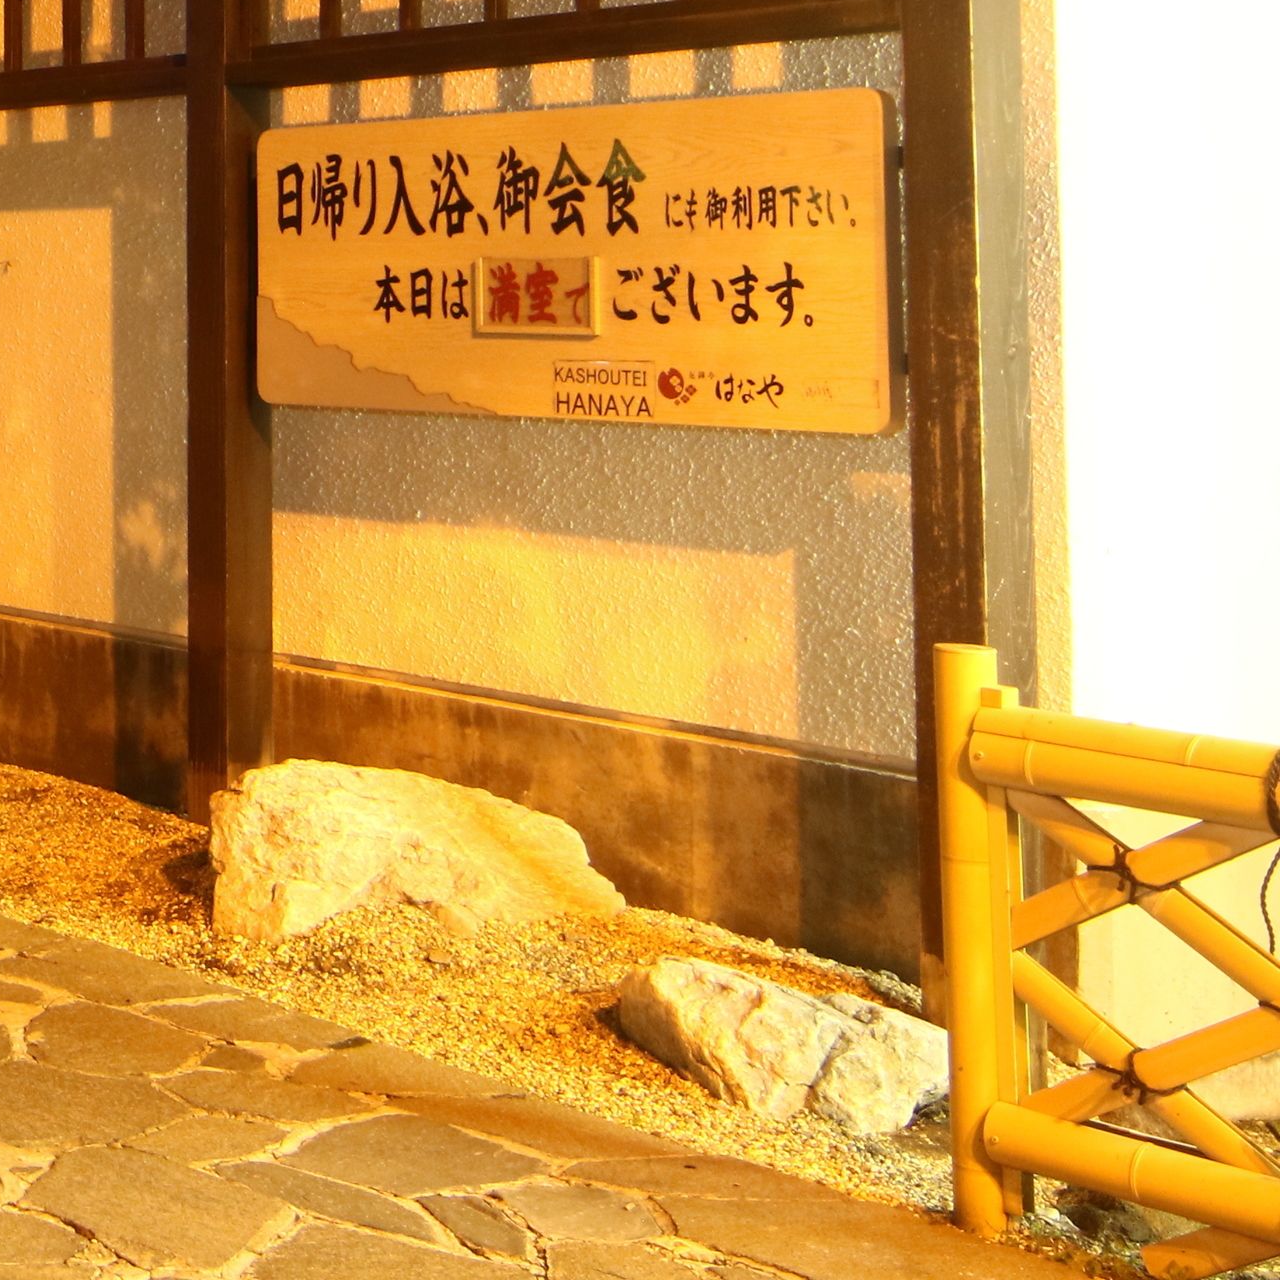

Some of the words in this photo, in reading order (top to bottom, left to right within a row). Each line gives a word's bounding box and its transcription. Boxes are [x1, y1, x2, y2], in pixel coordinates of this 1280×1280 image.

[276, 137, 647, 241] 日帰り入浴、御会食
[664, 184, 857, 231] にも御利用下さい。
[373, 264, 469, 323] 本日は
[612, 261, 814, 327] ございます。
[554, 366, 648, 387] KASHOUTEI
[714, 373, 784, 408] はなや
[555, 392, 653, 417] HANAYA
